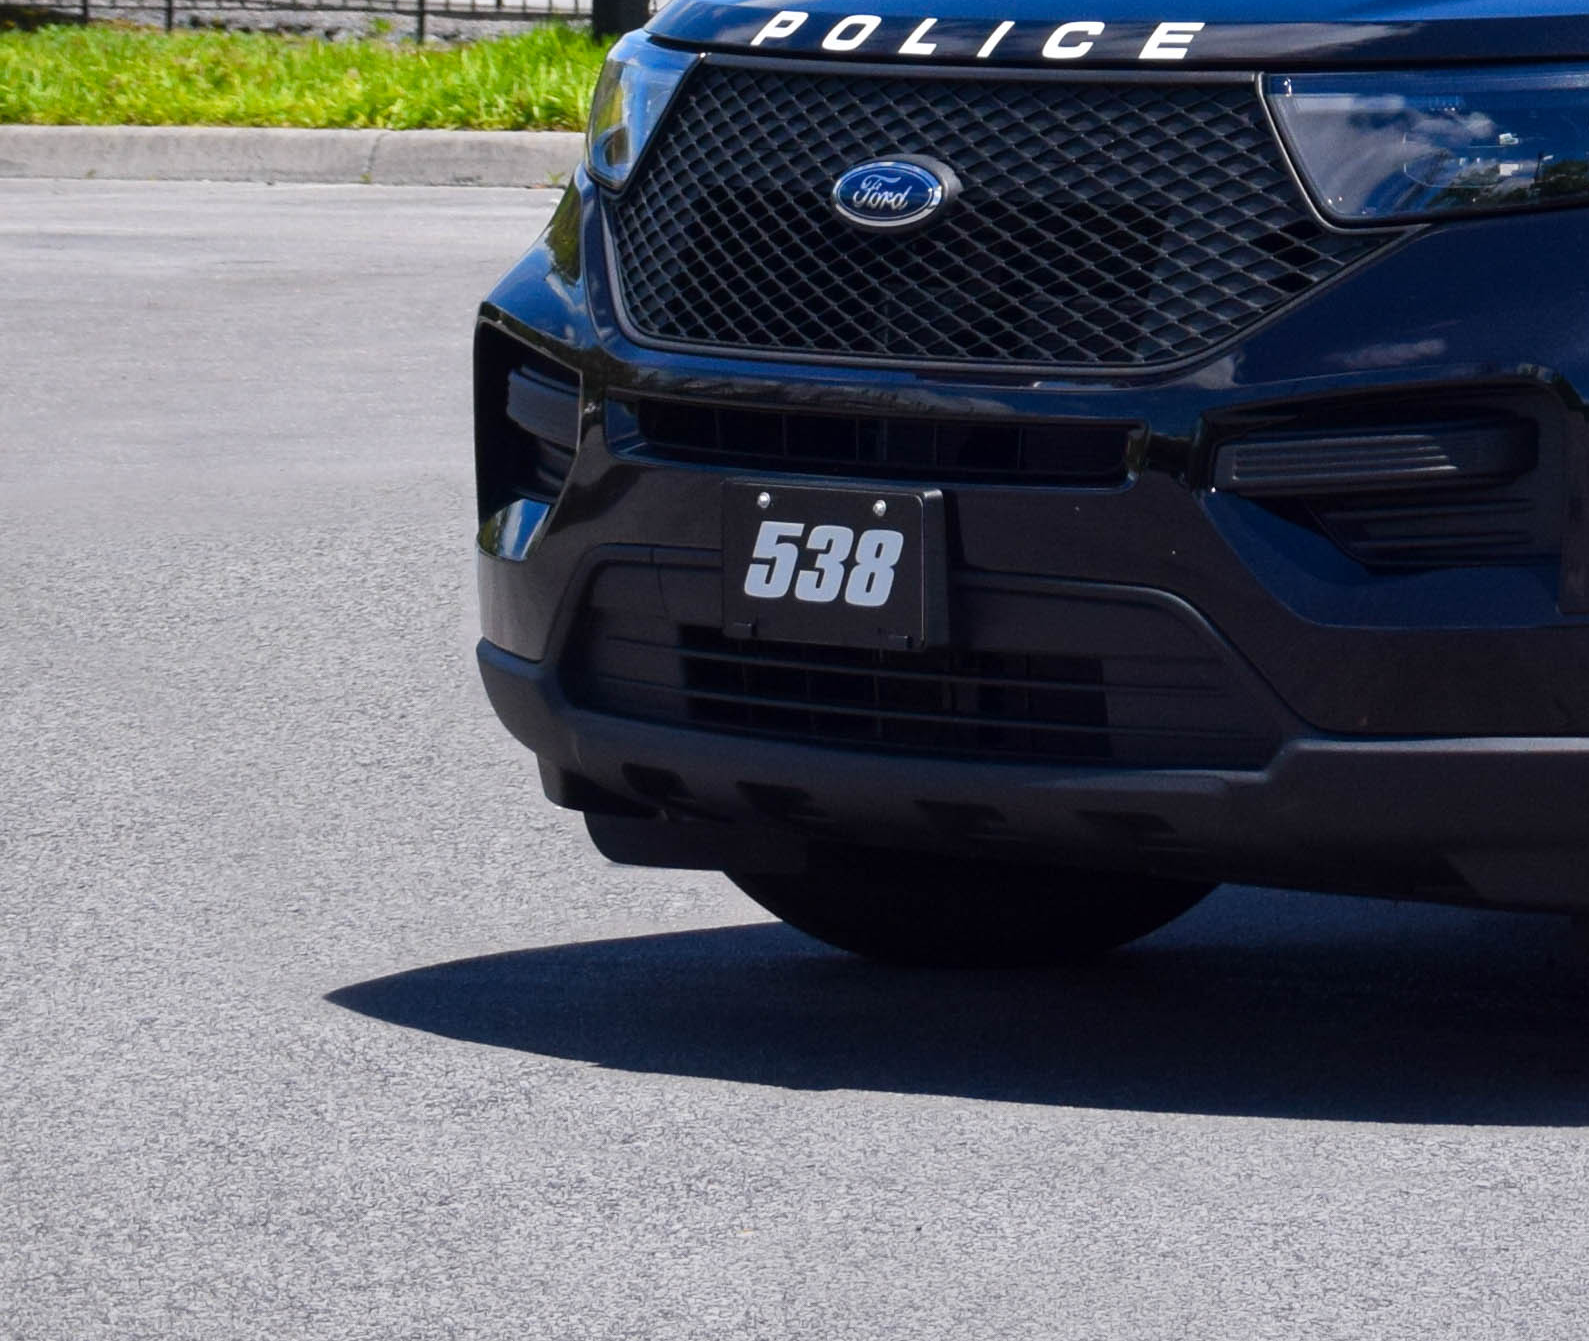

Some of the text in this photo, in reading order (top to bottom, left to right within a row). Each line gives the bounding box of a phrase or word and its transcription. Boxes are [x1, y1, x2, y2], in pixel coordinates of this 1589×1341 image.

[750, 10, 1206, 60] POLICE
[853, 174, 913, 210] Ford
[744, 521, 904, 607] 538
